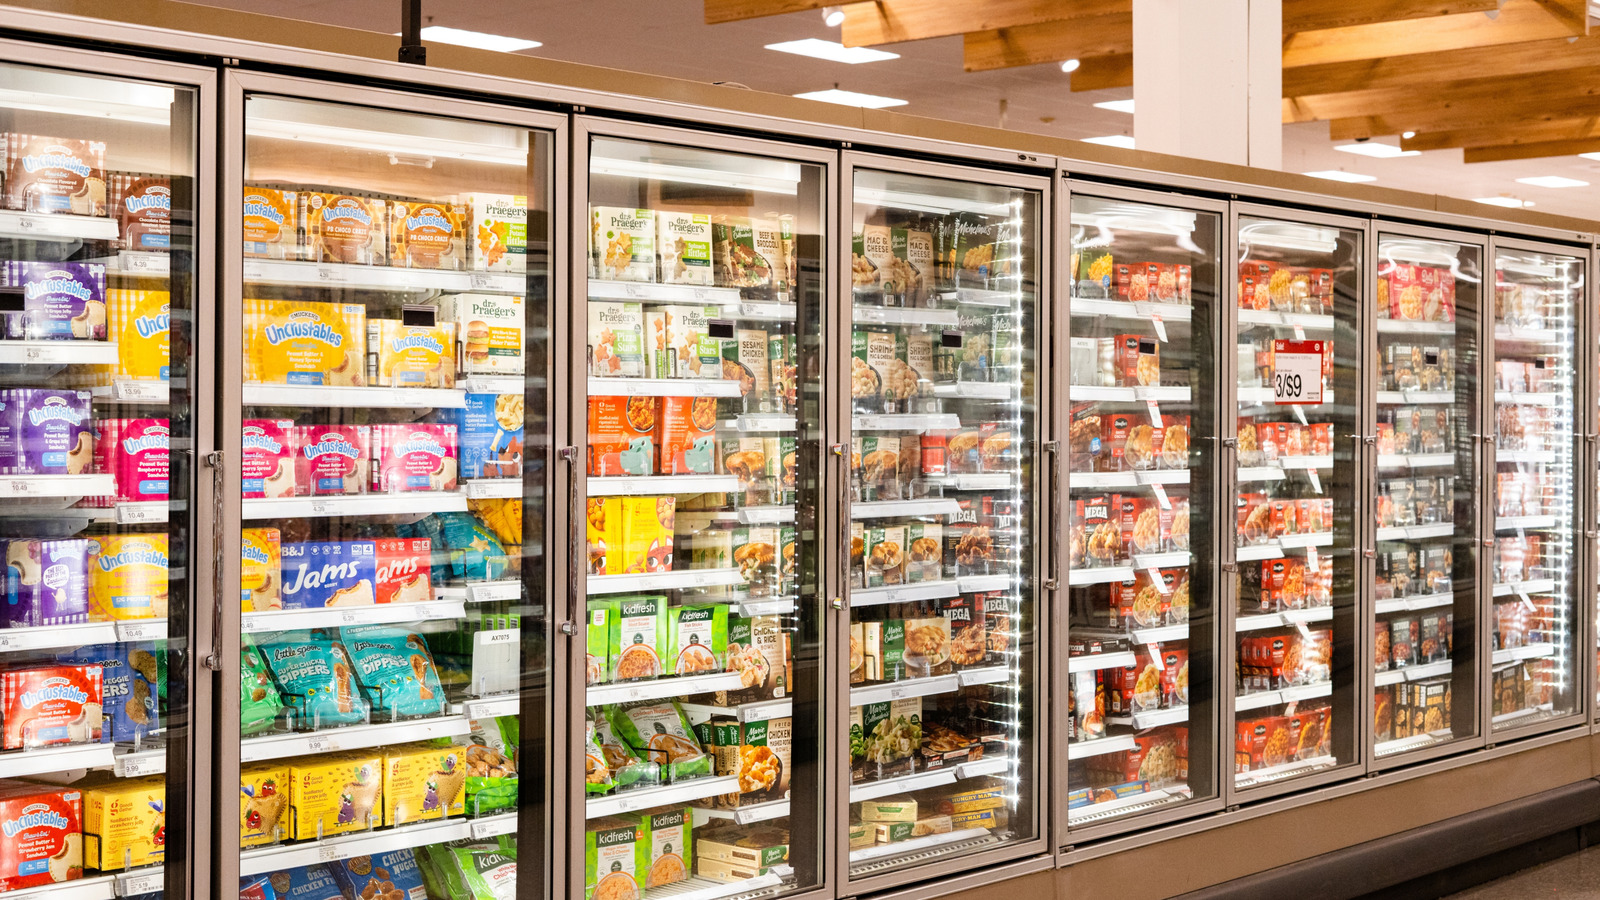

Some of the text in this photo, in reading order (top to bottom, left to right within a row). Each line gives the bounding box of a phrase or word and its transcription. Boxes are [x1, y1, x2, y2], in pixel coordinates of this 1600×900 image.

[23, 155, 90, 177] Uncrustables
[244, 203, 284, 224] rustables
[323, 207, 371, 225] Uncrustables
[486, 204, 526, 218] Praeger's
[407, 215, 452, 232] Uncrustables
[611, 217, 646, 229] Praeger's
[669, 222, 704, 234] Praeger's
[958, 221, 992, 236] Michelina's
[759, 231, 770, 239] BEEF
[867, 236, 881, 245] MAC
[757, 240, 779, 248] BROCCOLI
[867, 245, 889, 253] CHEESE
[910, 241, 923, 250] MAC
[688, 249, 706, 258] littles
[910, 250, 931, 258] CHEESE
[26, 279, 91, 300] Uncrustables
[473, 304, 515, 318] Praeger's
[265, 322, 341, 346] Uncrustables
[617, 332, 637, 341] Pizza
[393, 336, 443, 353] Uncrustables
[700, 336, 715, 345] Taco
[743, 341, 764, 349] SESAME
[618, 343, 637, 352] Stars
[700, 346, 716, 355] Stars
[742, 349, 764, 357] CHICKEN
[869, 344, 893, 353] SHRIMP
[910, 346, 931, 355] SHRIMP
[1276, 374, 1302, 399] 3/$9
[29, 404, 82, 426] Uncrustables
[304, 441, 359, 460] Uncrustables
[393, 439, 445, 457] Uncrustables
[949, 510, 978, 525] MEGA
[1085, 507, 1108, 519] MEGA
[282, 546, 304, 556] B&J
[99, 550, 168, 571] Uncrustable
[376, 557, 419, 584] ams
[283, 561, 360, 595] Jams
[623, 603, 655, 615] kidfresh
[943, 608, 970, 621] MEGA
[682, 611, 708, 620] kidfresh
[887, 626, 902, 635] Marie
[278, 664, 300, 675] SUPER
[279, 666, 331, 684] DIPPERS
[21, 685, 87, 708] Uncrustables
[868, 703, 888, 714] Marie
[749, 727, 765, 736] Marie
[769, 729, 791, 739] CHICKEN
[928, 760, 943, 768] MEGA
[3, 811, 68, 837] Uncrustables
[653, 813, 682, 827] kidfresh
[600, 830, 633, 843] kidfresh
[292, 880, 324, 895] CHICKEN
